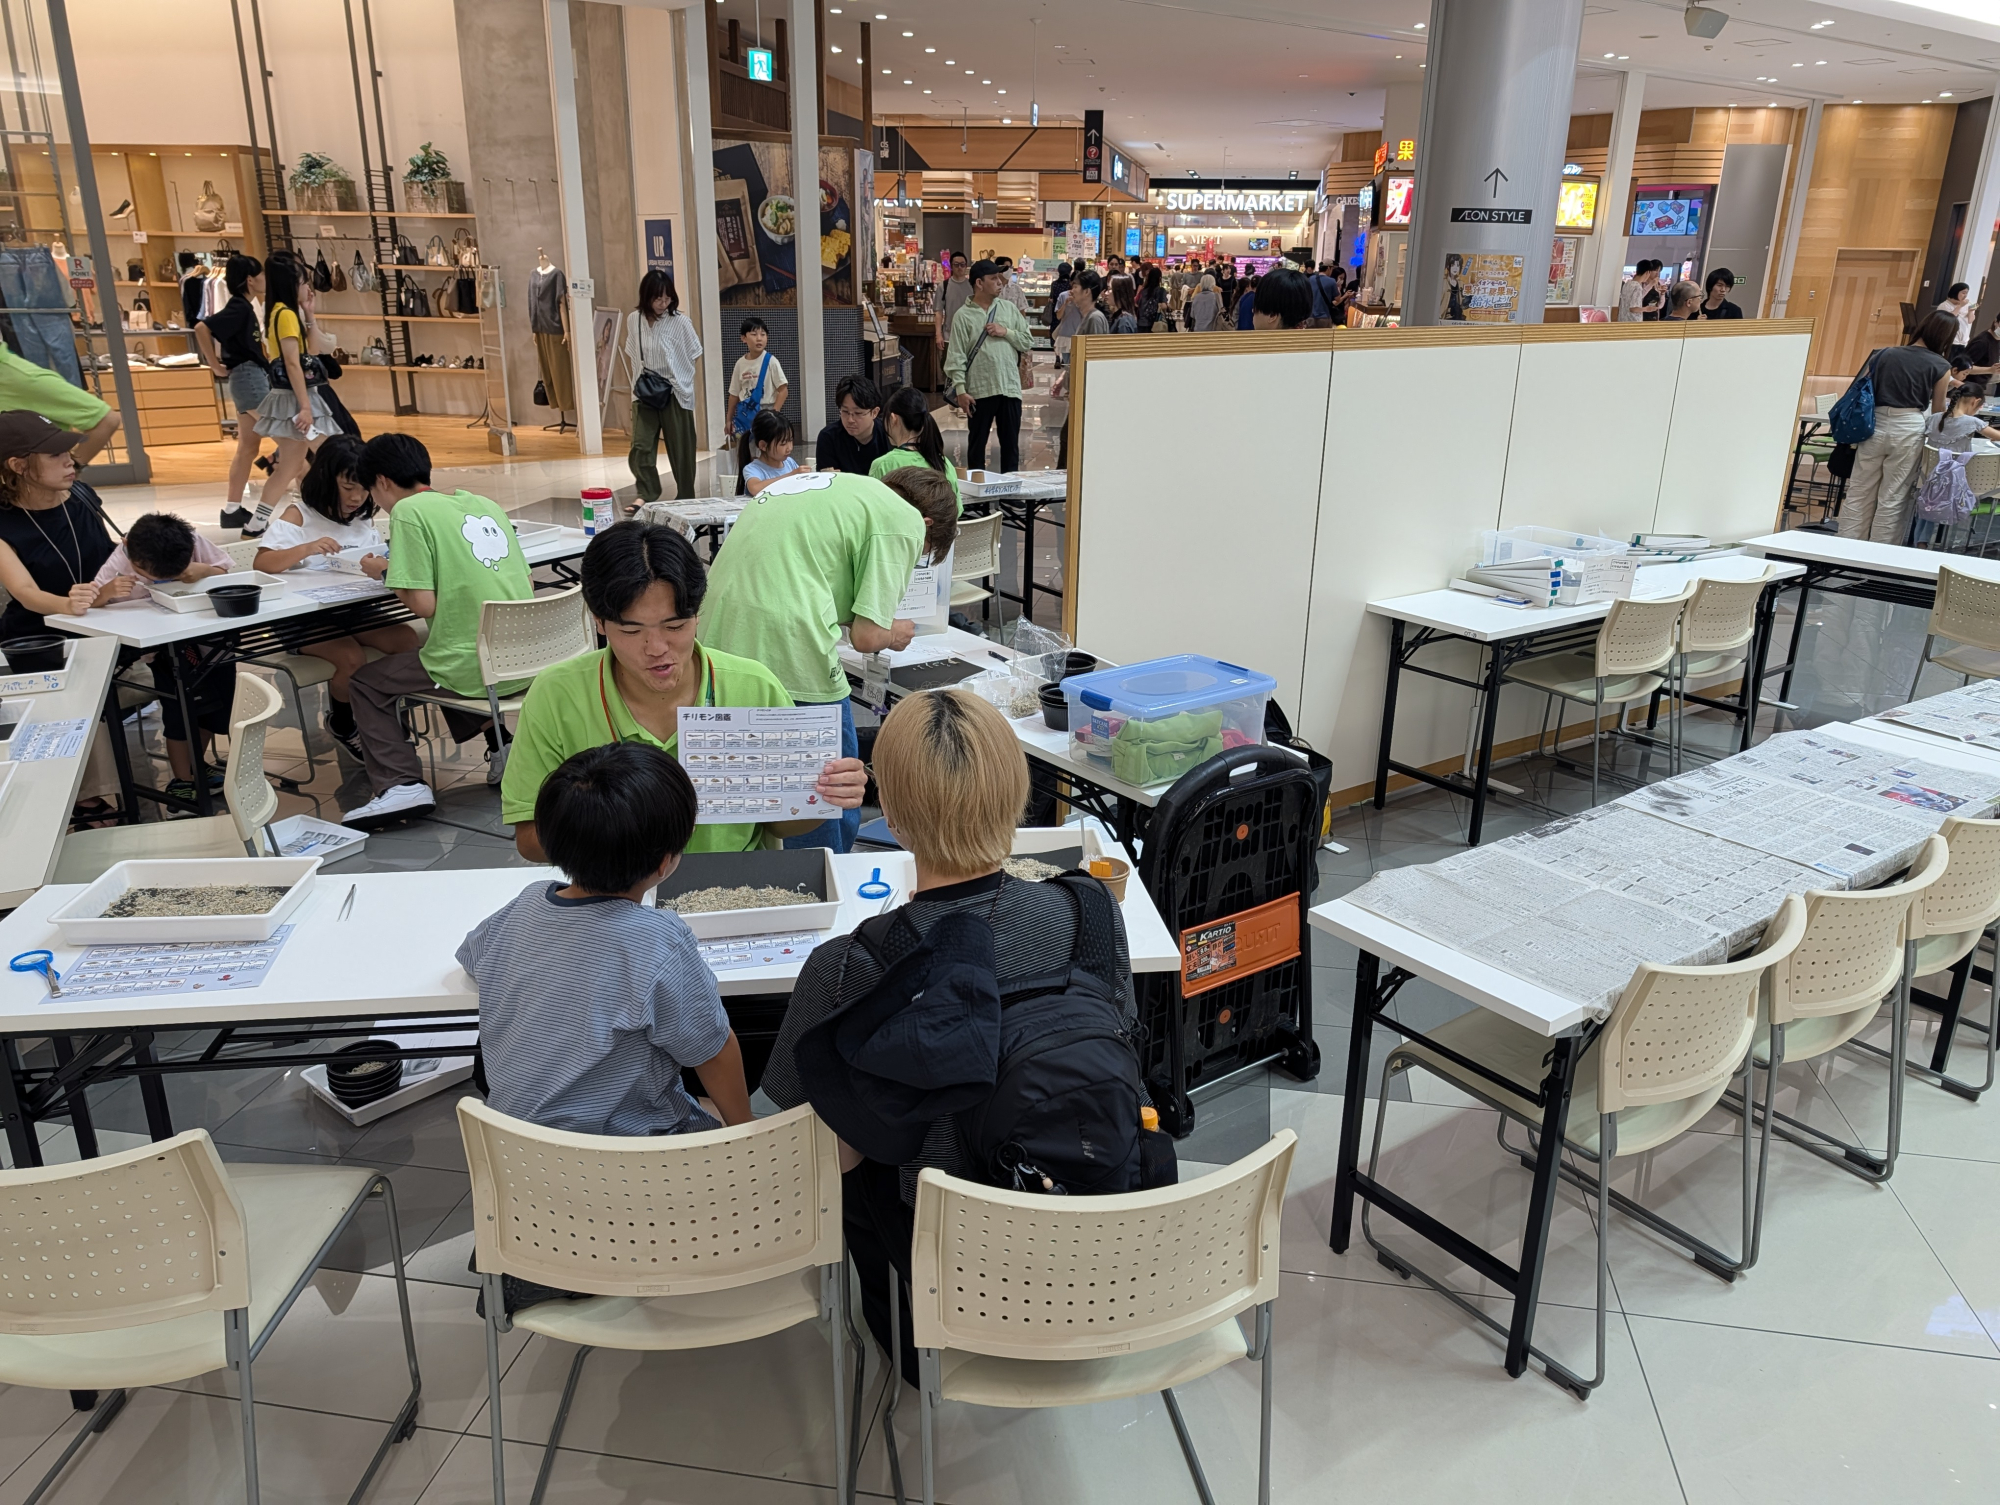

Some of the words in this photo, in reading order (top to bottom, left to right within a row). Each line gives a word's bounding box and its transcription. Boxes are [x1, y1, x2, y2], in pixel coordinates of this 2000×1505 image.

[1166, 192, 1307, 212] SUPERMARKET
[1491, 211, 1525, 222] STYLE
[1190, 234, 1222, 245] MET
[653, 235, 665, 257] UR
[74, 258, 84, 270] R
[682, 712, 732, 722] チリモン図鑑
[1200, 926, 1232, 942] KARTIO
